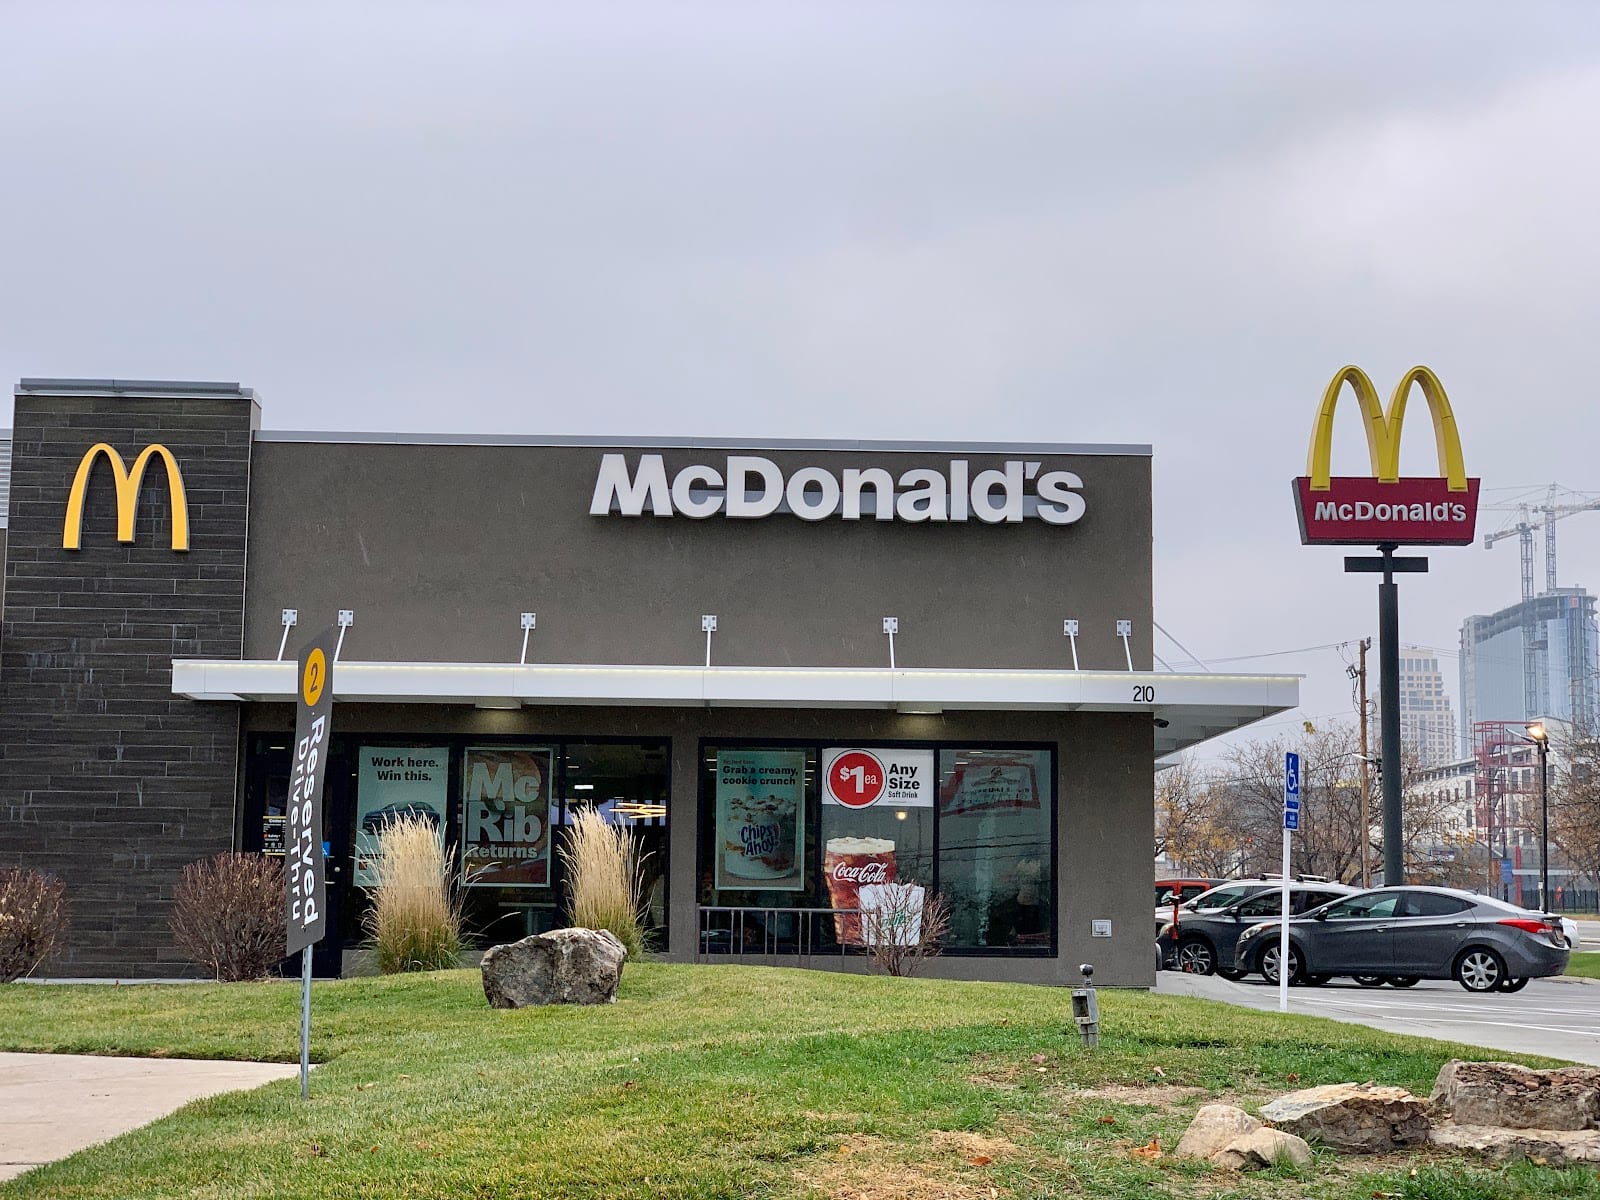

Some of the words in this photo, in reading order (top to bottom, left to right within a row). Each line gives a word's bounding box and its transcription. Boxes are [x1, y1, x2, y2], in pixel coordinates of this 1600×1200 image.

[588, 453, 1087, 525] McDonald's
[1314, 501, 1467, 522] McDonald's
[309, 662, 319, 694] 2
[1132, 685, 1155, 703] 210
[371, 757, 404, 768] Work
[407, 757, 439, 768] here.
[722, 765, 748, 774] Grab
[758, 767, 799, 776] creamy,
[888, 763, 918, 779] Any
[377, 770, 400, 781] Win
[404, 771, 432, 782] this.
[468, 762, 541, 803] Mc
[722, 776, 758, 785] cookie
[759, 776, 796, 785] crunch
[888, 777, 920, 790] Size
[887, 790, 901, 798] Soft
[290, 735, 310, 921] Drive-Thru
[301, 714, 326, 925] Reserved
[467, 801, 542, 844] Rib
[466, 843, 538, 859] Returns
